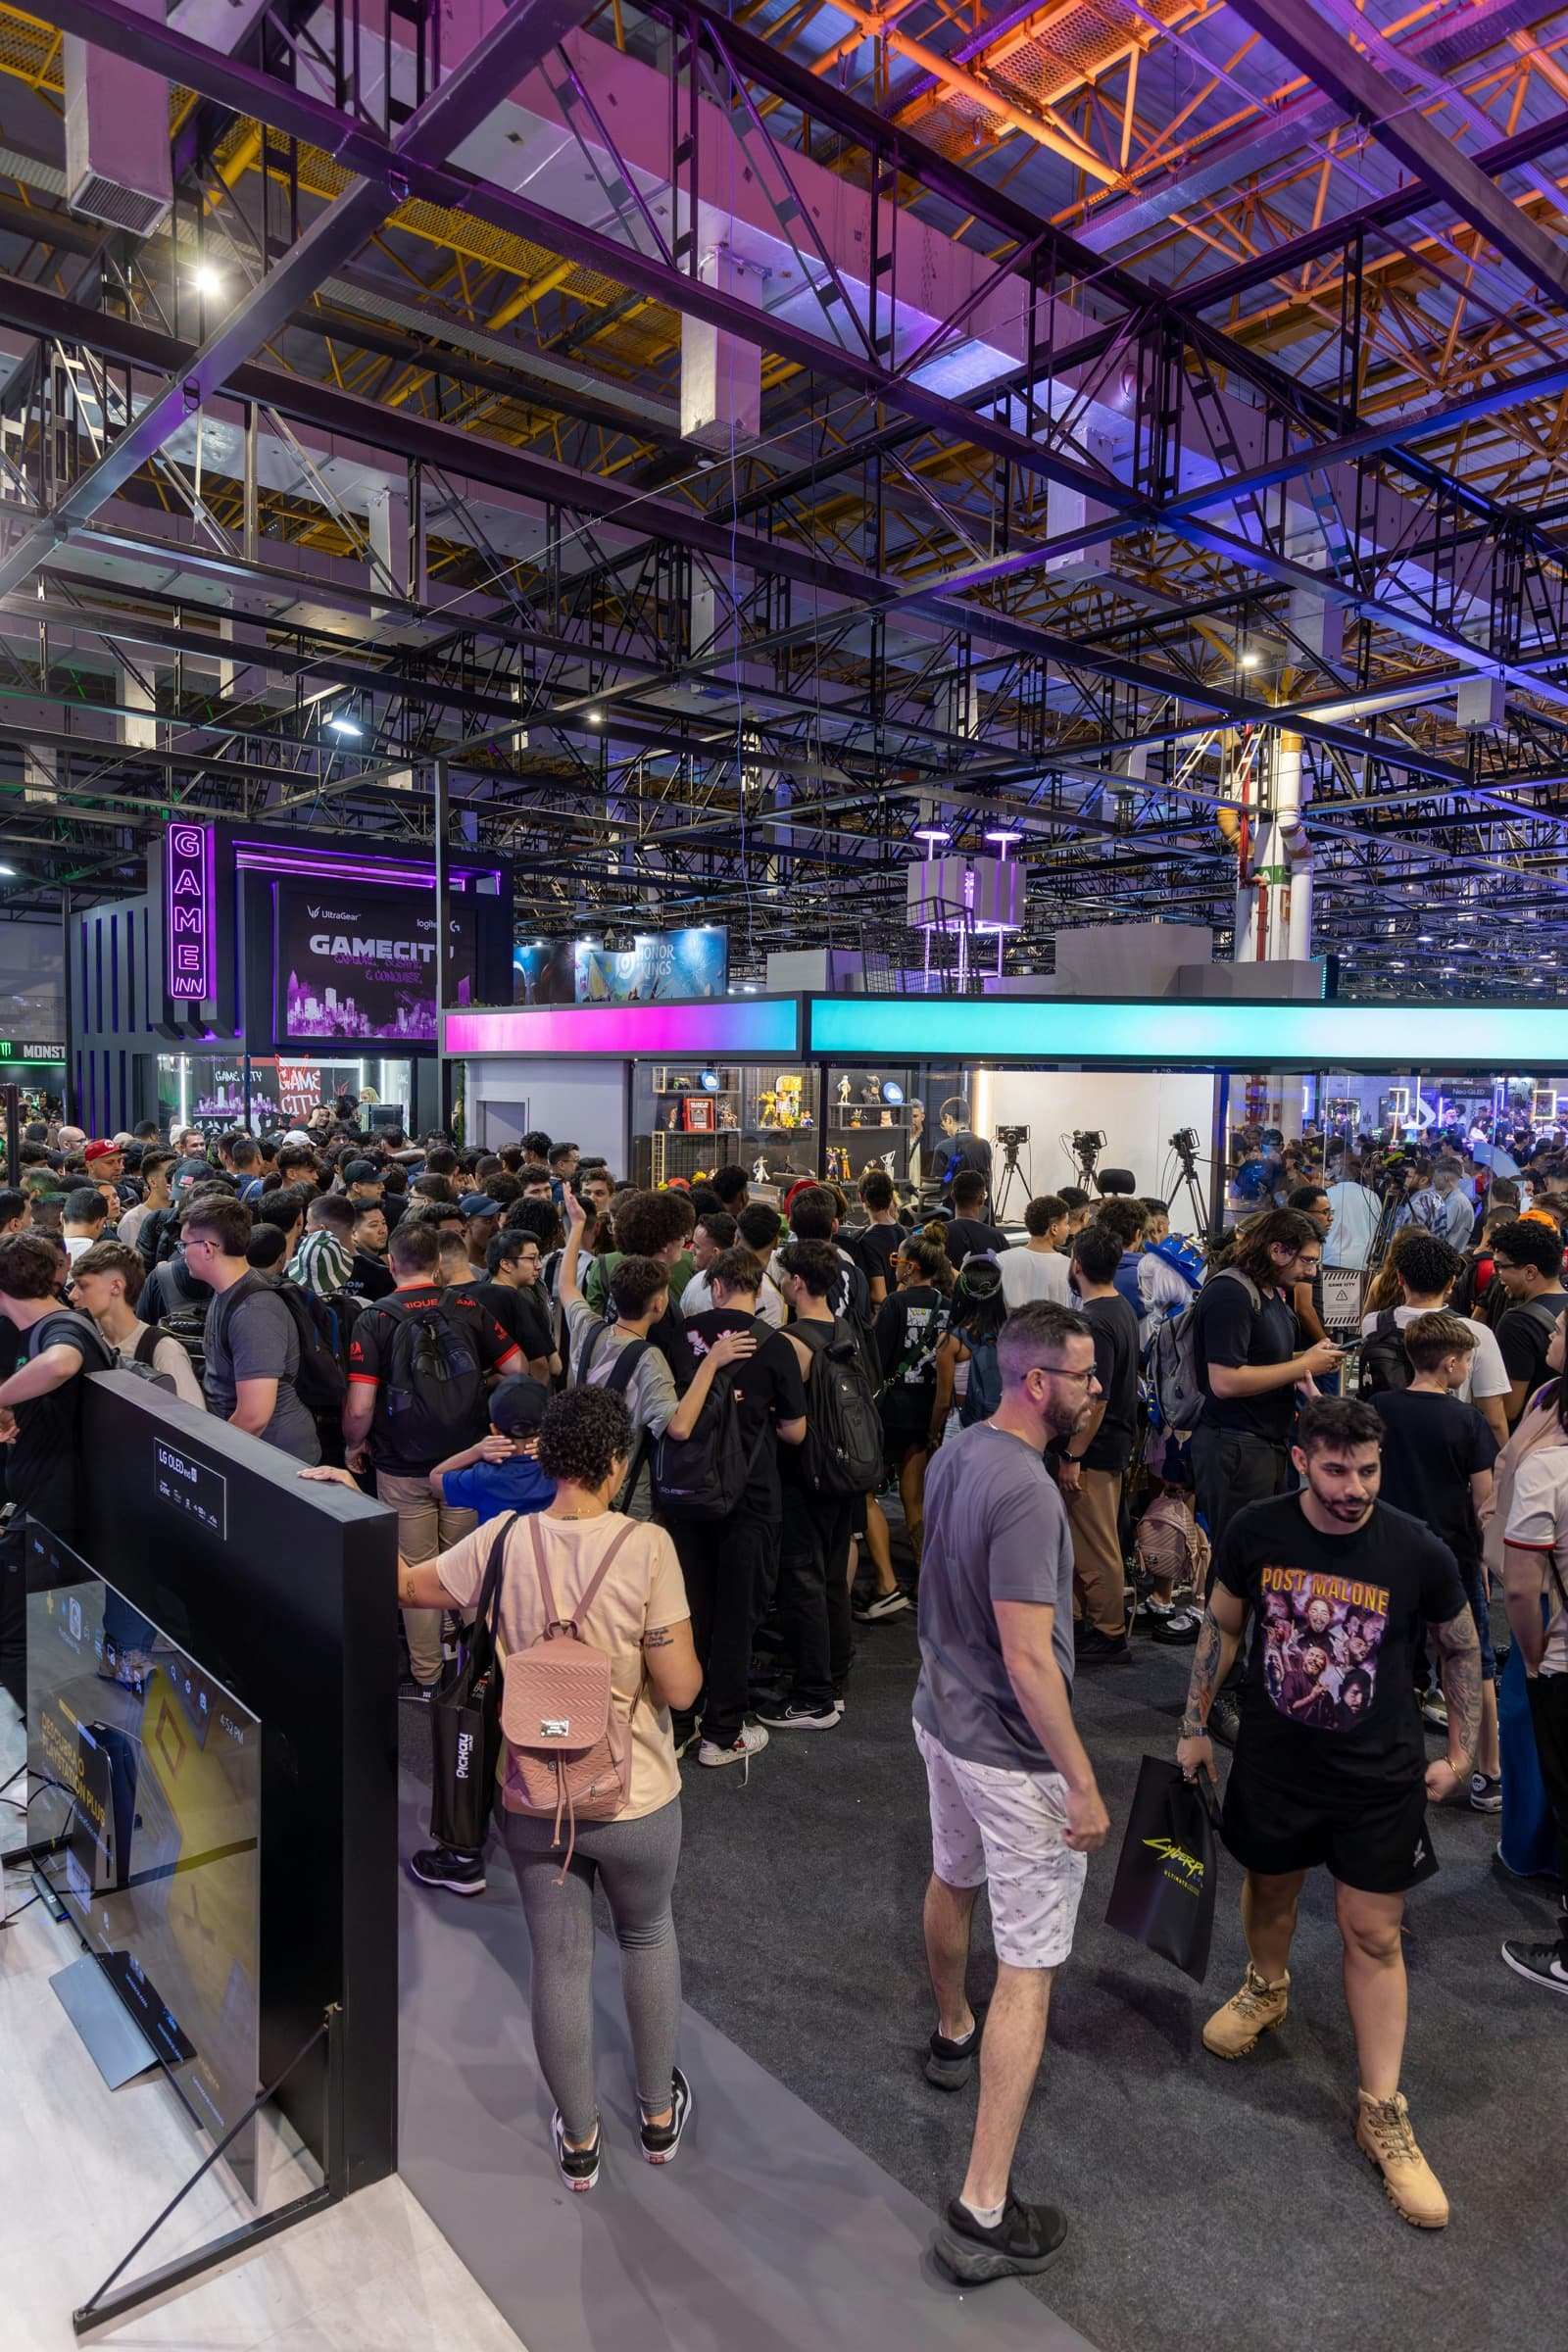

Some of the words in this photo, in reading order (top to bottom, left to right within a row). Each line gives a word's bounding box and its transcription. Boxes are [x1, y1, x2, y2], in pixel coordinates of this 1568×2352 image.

[173, 831, 202, 971] GAME
[321, 910, 359, 921] UltraGear
[175, 977, 203, 994] INN
[24, 1045, 66, 1058] MONST
[159, 1447, 168, 1465] LG
[168, 1453, 184, 1475] OLED
[1261, 1566, 1306, 1593] POST
[1311, 1573, 1390, 1617] MALONE
[86, 1789, 106, 1828] PLUS
